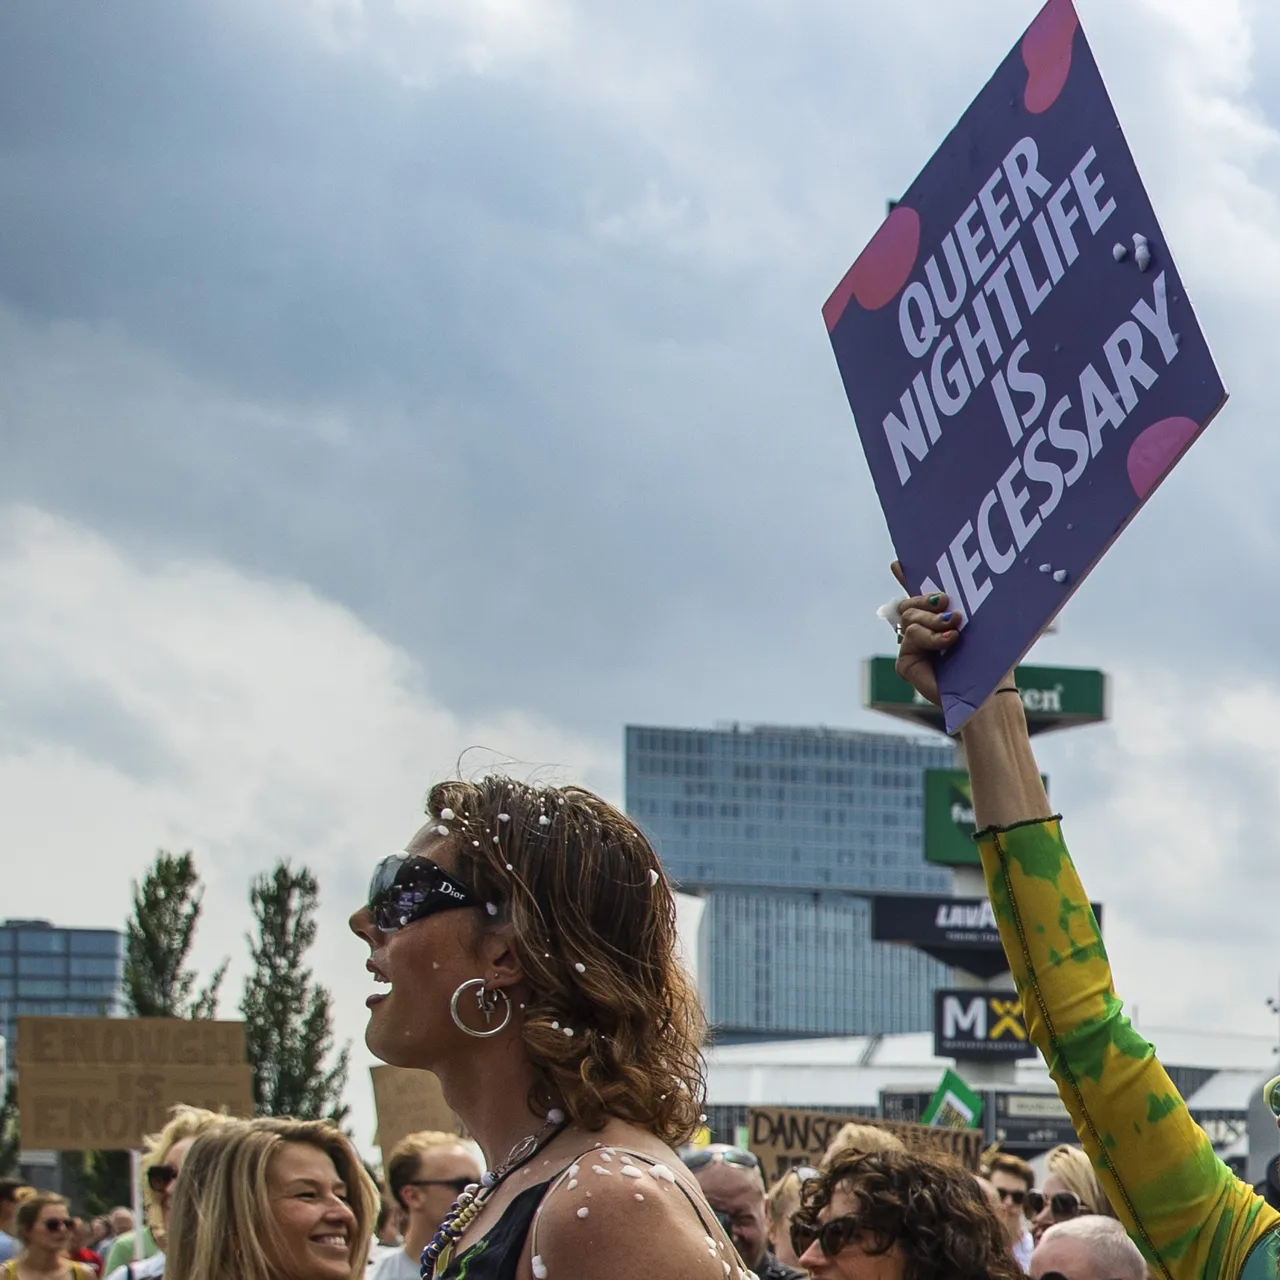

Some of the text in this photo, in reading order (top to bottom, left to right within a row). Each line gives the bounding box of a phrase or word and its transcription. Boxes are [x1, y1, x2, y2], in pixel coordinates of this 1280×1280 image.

[882, 145, 1117, 486] NIGHTLIFE
[898, 136, 1052, 358] QUEER
[919, 271, 1180, 636] NECESSARY
[990, 340, 1047, 448] IS
